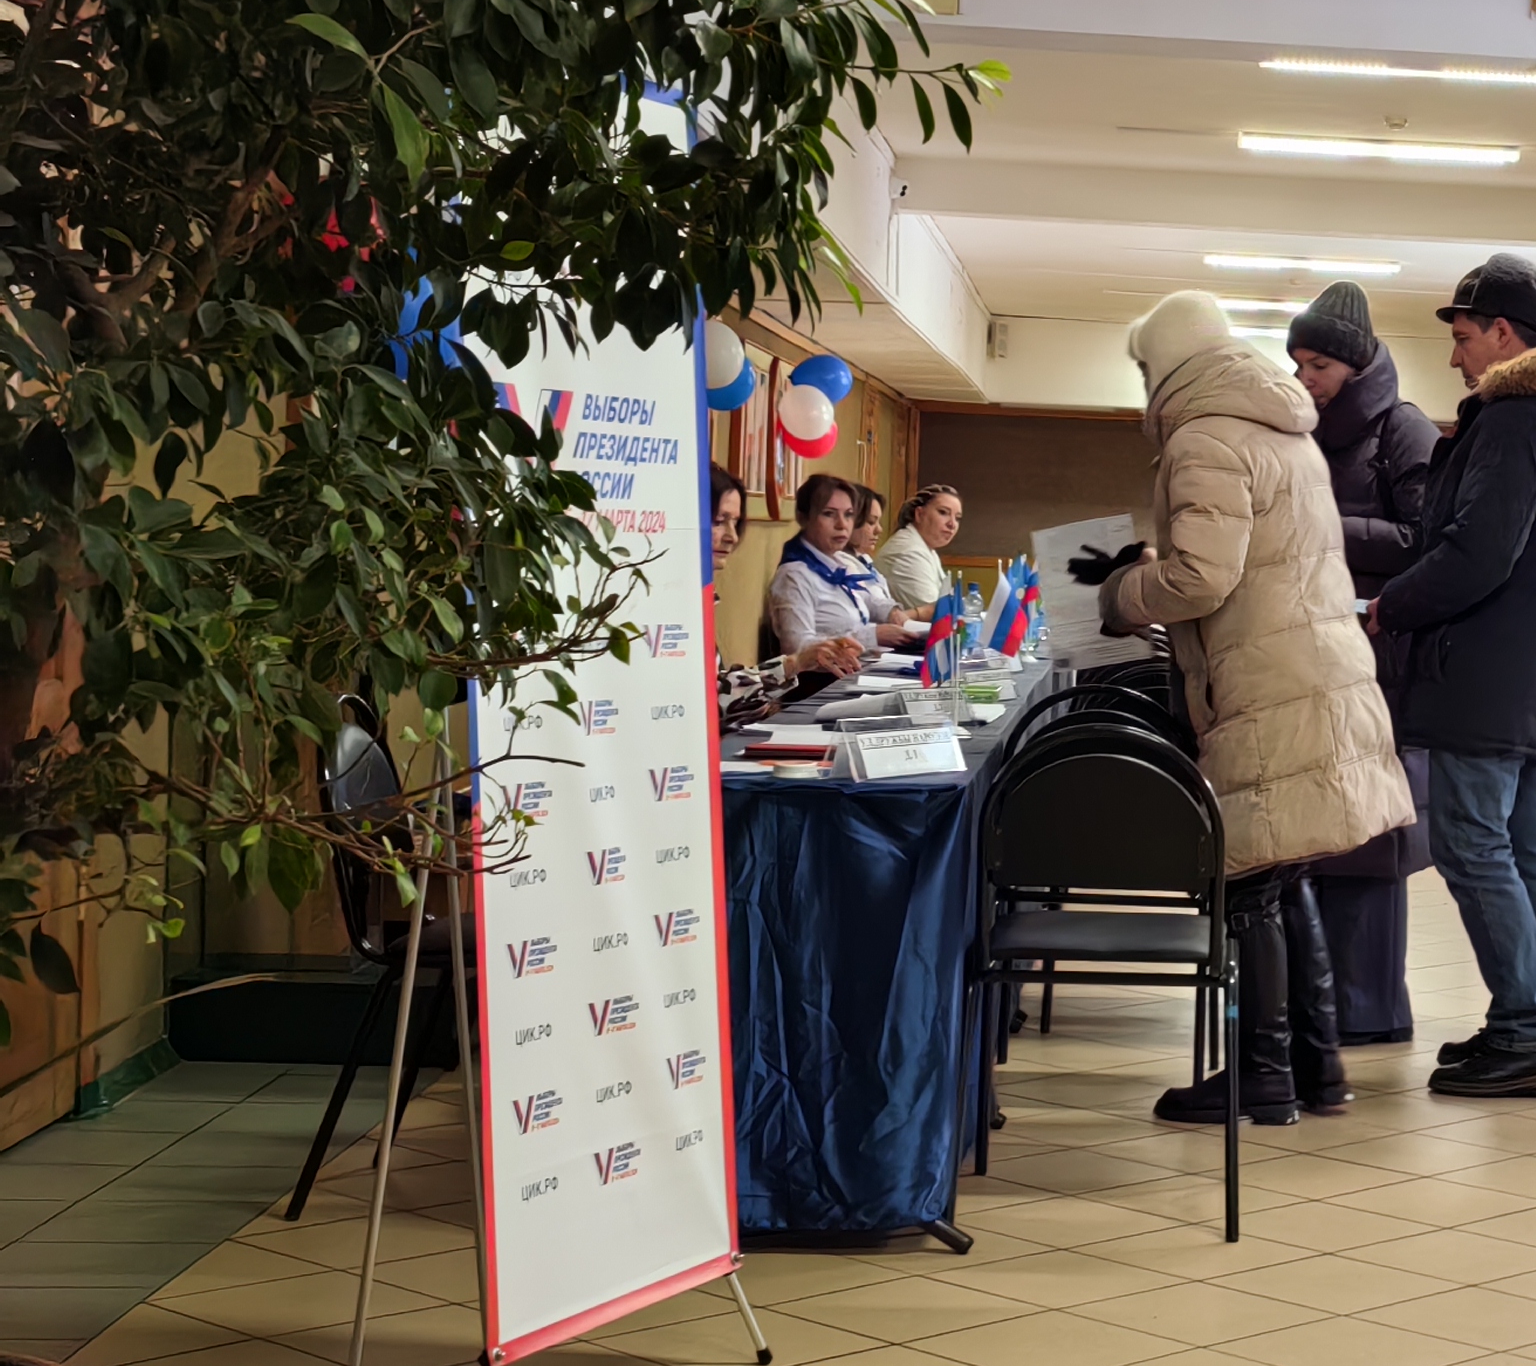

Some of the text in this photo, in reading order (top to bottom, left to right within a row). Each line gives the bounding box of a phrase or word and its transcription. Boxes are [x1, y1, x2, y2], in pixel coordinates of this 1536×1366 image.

[582, 394, 656, 426] ВЫБОРЫ
[573, 432, 678, 466] ПРЕЗИДЕНТА
[577, 470, 634, 500] ССИИ
[638, 510, 666, 533] 2024
